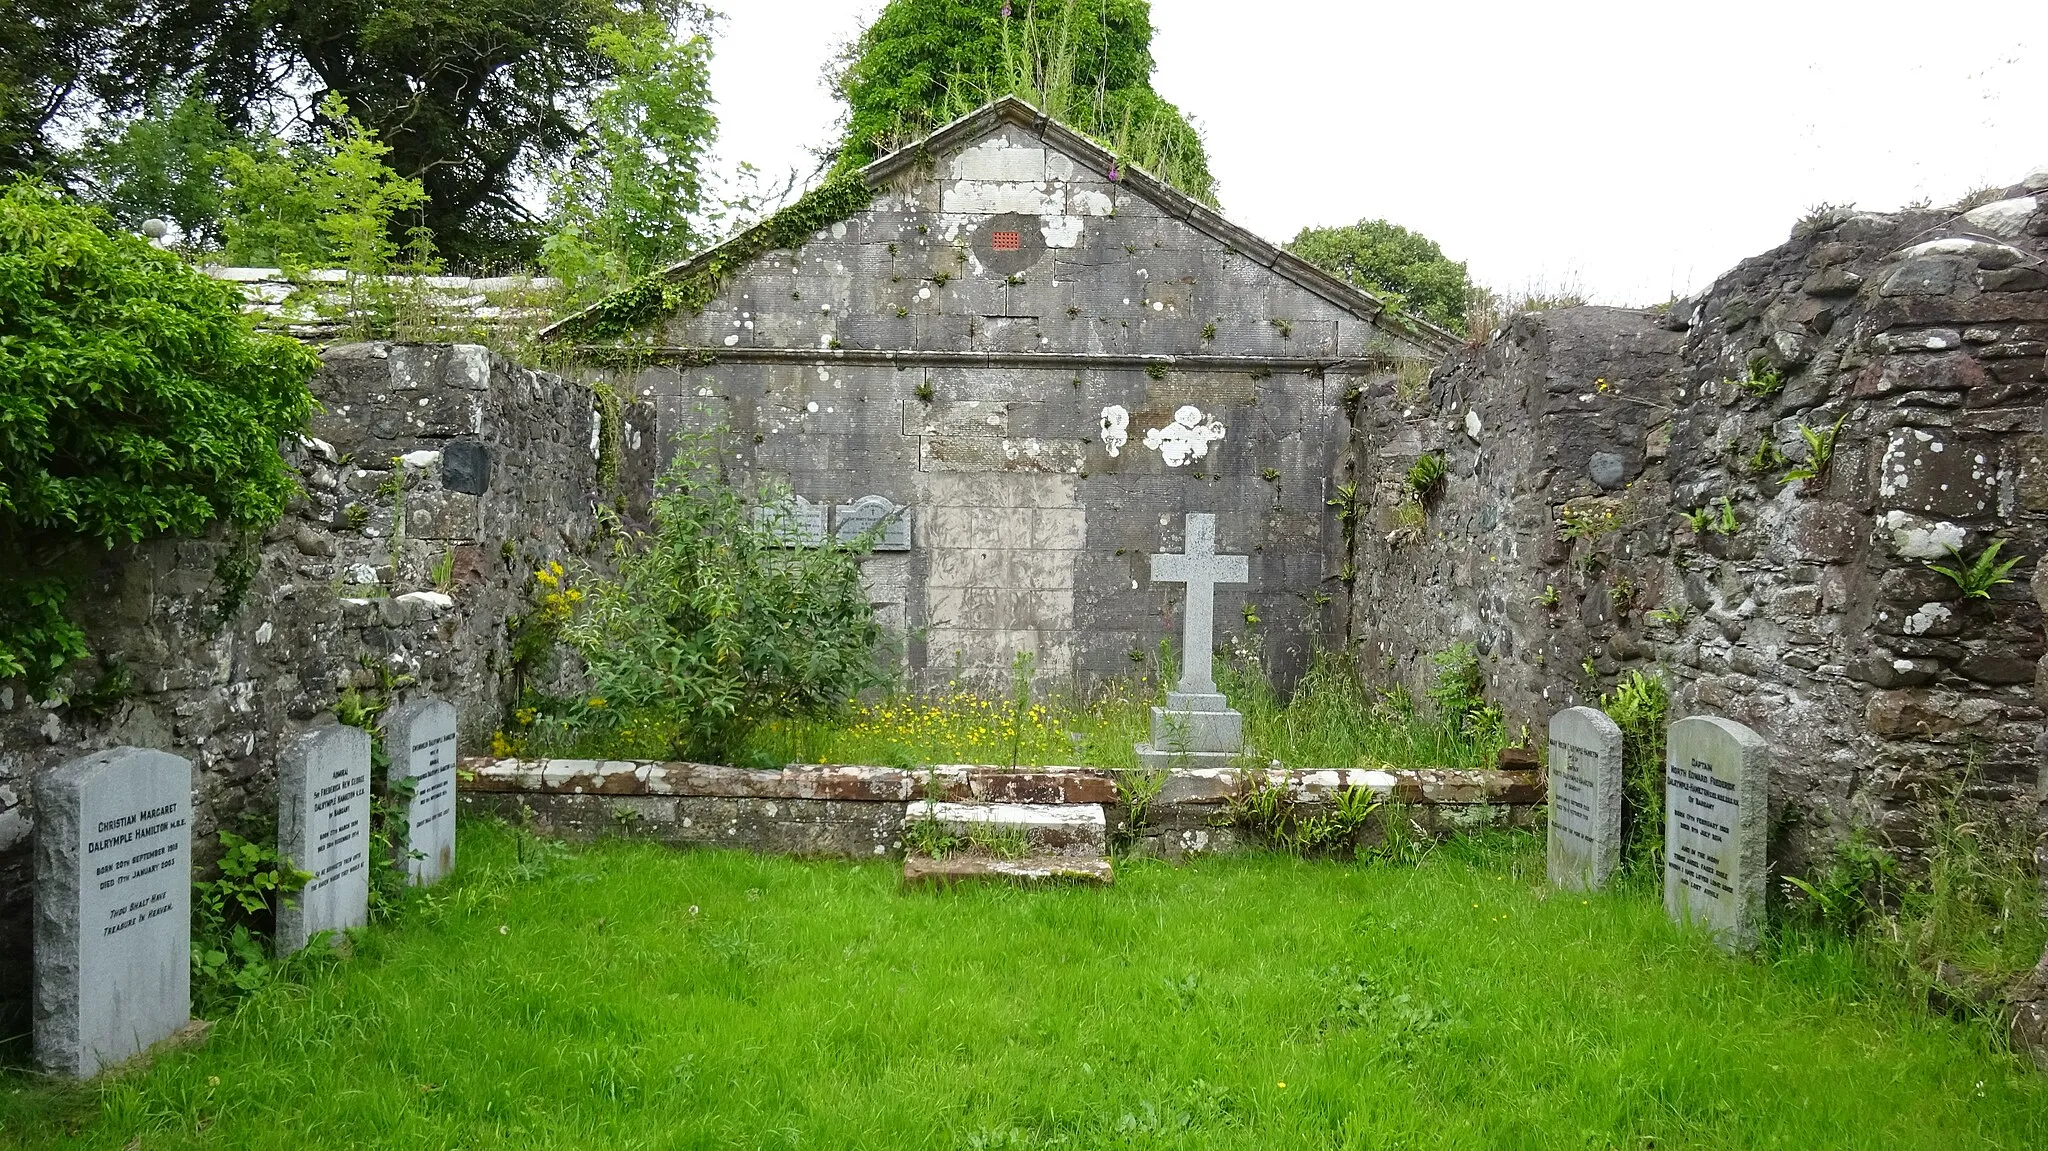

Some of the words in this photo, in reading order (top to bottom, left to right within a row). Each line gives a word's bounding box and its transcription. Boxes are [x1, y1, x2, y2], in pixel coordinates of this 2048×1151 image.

[98, 814, 136, 833] CHRISTIAN
[140, 803, 177, 821] MARGARET
[88, 832, 133, 854] DALRYMPLE
[135, 821, 168, 840] HAMILTON
[96, 863, 113, 876] BORN
[132, 846, 165, 864] SEPTEMBER
[100, 878, 114, 890] DIED
[132, 864, 159, 879] JANUARY
[109, 906, 127, 919] THOU
[129, 897, 150, 912] SHALT
[150, 891, 167, 904] HAVE
[103, 917, 136, 937] TREASURE
[138, 913, 145, 923] IN
